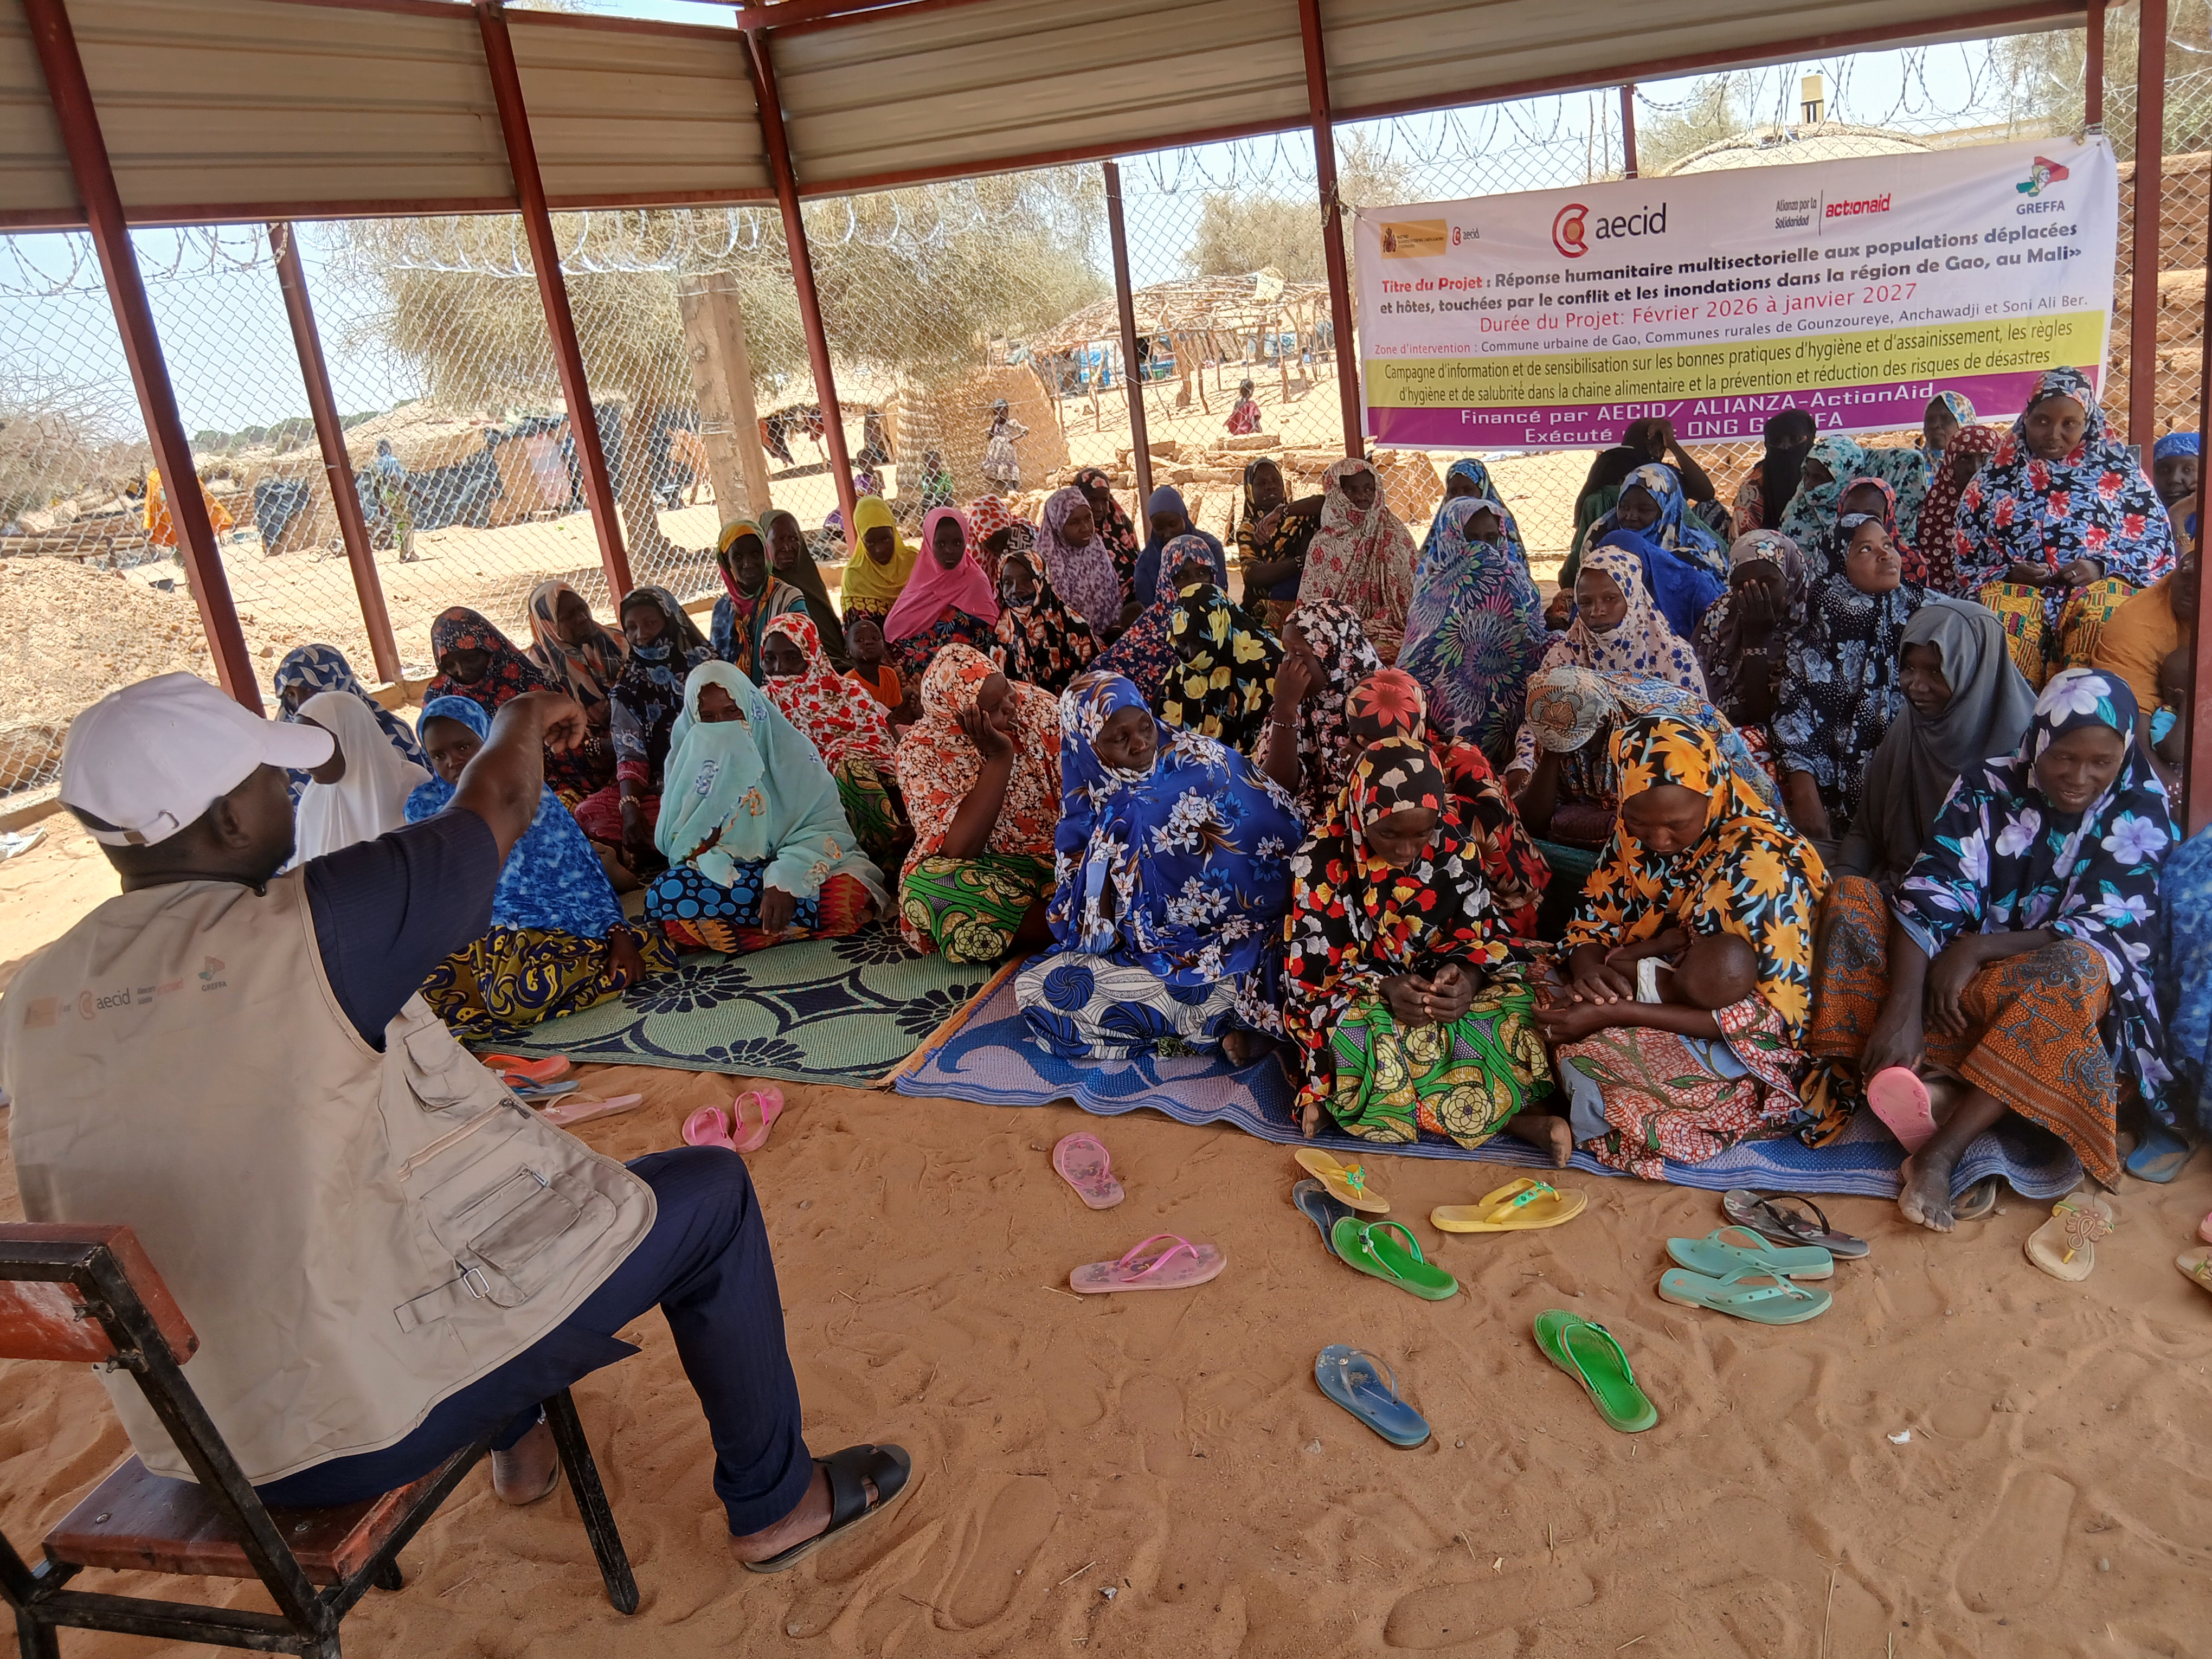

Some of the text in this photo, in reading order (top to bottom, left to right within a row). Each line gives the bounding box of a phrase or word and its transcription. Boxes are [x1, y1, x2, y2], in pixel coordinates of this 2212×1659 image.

[1596, 202, 1667, 240] aecid
[1776, 197, 1817, 213] Alianza por la
[2016, 200, 2066, 215] GREFFA
[1463, 228, 1480, 240] aecid
[1775, 215, 1809, 229] Solidaridad
[1381, 280, 1412, 294] Titre
[1415, 278, 1434, 292] du
[1438, 276, 1483, 292] Projet
[1495, 272, 1561, 289] Réponse
[1565, 262, 1673, 283] humanitaire
[1678, 247, 1819, 274] multisectorielle
[1824, 246, 1860, 260] aux
[1866, 233, 1978, 259] populations
[1984, 222, 2078, 245] déplacées
[1380, 301, 1393, 314] et
[1396, 299, 1435, 314] hôtes,
[1438, 295, 1502, 312] touchées
[1507, 297, 1535, 311] par
[1539, 292, 1553, 307] le
[1557, 289, 1610, 306] conflit
[1614, 288, 1632, 302] et
[1636, 286, 1658, 300] les
[1664, 277, 1771, 298] inondations
[1777, 272, 1821, 287] dans
[1827, 268, 1844, 283] la
[1850, 263, 1911, 281] région
[1916, 258, 1940, 274] de
[1945, 255, 1990, 271] Gao,
[1996, 254, 2021, 266] au
[1480, 282, 1917, 333] Durée du Projet: Février 2026 à janvier 2027
[1375, 344, 1397, 355] Zone
[1481, 341, 1539, 352] Commune
[1543, 337, 1589, 350] urbaine
[1593, 335, 1608, 347] de
[1612, 334, 1641, 346] Gao,
[1645, 329, 1719, 343] Communes
[1725, 323, 1771, 337] rurales
[1776, 320, 1792, 333] de
[1797, 314, 1894, 331] Gounzoureye,
[1899, 303, 1979, 322] Anchawadji
[1984, 303, 1998, 314] et
[2003, 298, 2032, 313] Soni
[2037, 296, 2056, 310] Ali
[2062, 295, 2087, 307] Ber.
[1385, 364, 1435, 383] Campagne
[1512, 362, 1524, 377] et
[1527, 360, 1541, 376] de
[1545, 356, 1628, 376] sensibilisation
[1632, 358, 1652, 371] sur
[1656, 352, 1673, 370] les
[1677, 351, 1725, 368] bonnes
[1729, 345, 1791, 369] pratiques
[1866, 337, 1880, 353] et
[2008, 323, 2027, 340] les
[2031, 319, 2073, 342] règles
[1449, 387, 1459, 401] et
[1461, 385, 1475, 401] de
[1478, 381, 1525, 401] salubrité
[1528, 383, 1555, 400] dans
[1559, 382, 1568, 398] la
[1572, 381, 1611, 398] chaine
[1615, 376, 1685, 396] alimentaire
[1689, 377, 1702, 391] et
[1706, 374, 1716, 391] la
[1721, 369, 1792, 394] prévention
[1796, 368, 1810, 384] et
[1814, 362, 1879, 382] réduction
[1883, 358, 1907, 377] des
[1911, 357, 1959, 376] risques
[1964, 352, 1981, 370] de
[1985, 349, 2050, 368] désastres
[1461, 410, 1541, 425] Financé
[1549, 411, 1589, 426] par
[1525, 427, 1612, 443] Exécuté
[1688, 419, 1738, 437] ONG
[1749, 411, 1843, 433] GFA
[97, 988, 131, 1009] aecid
[202, 981, 227, 992] GREFFA
